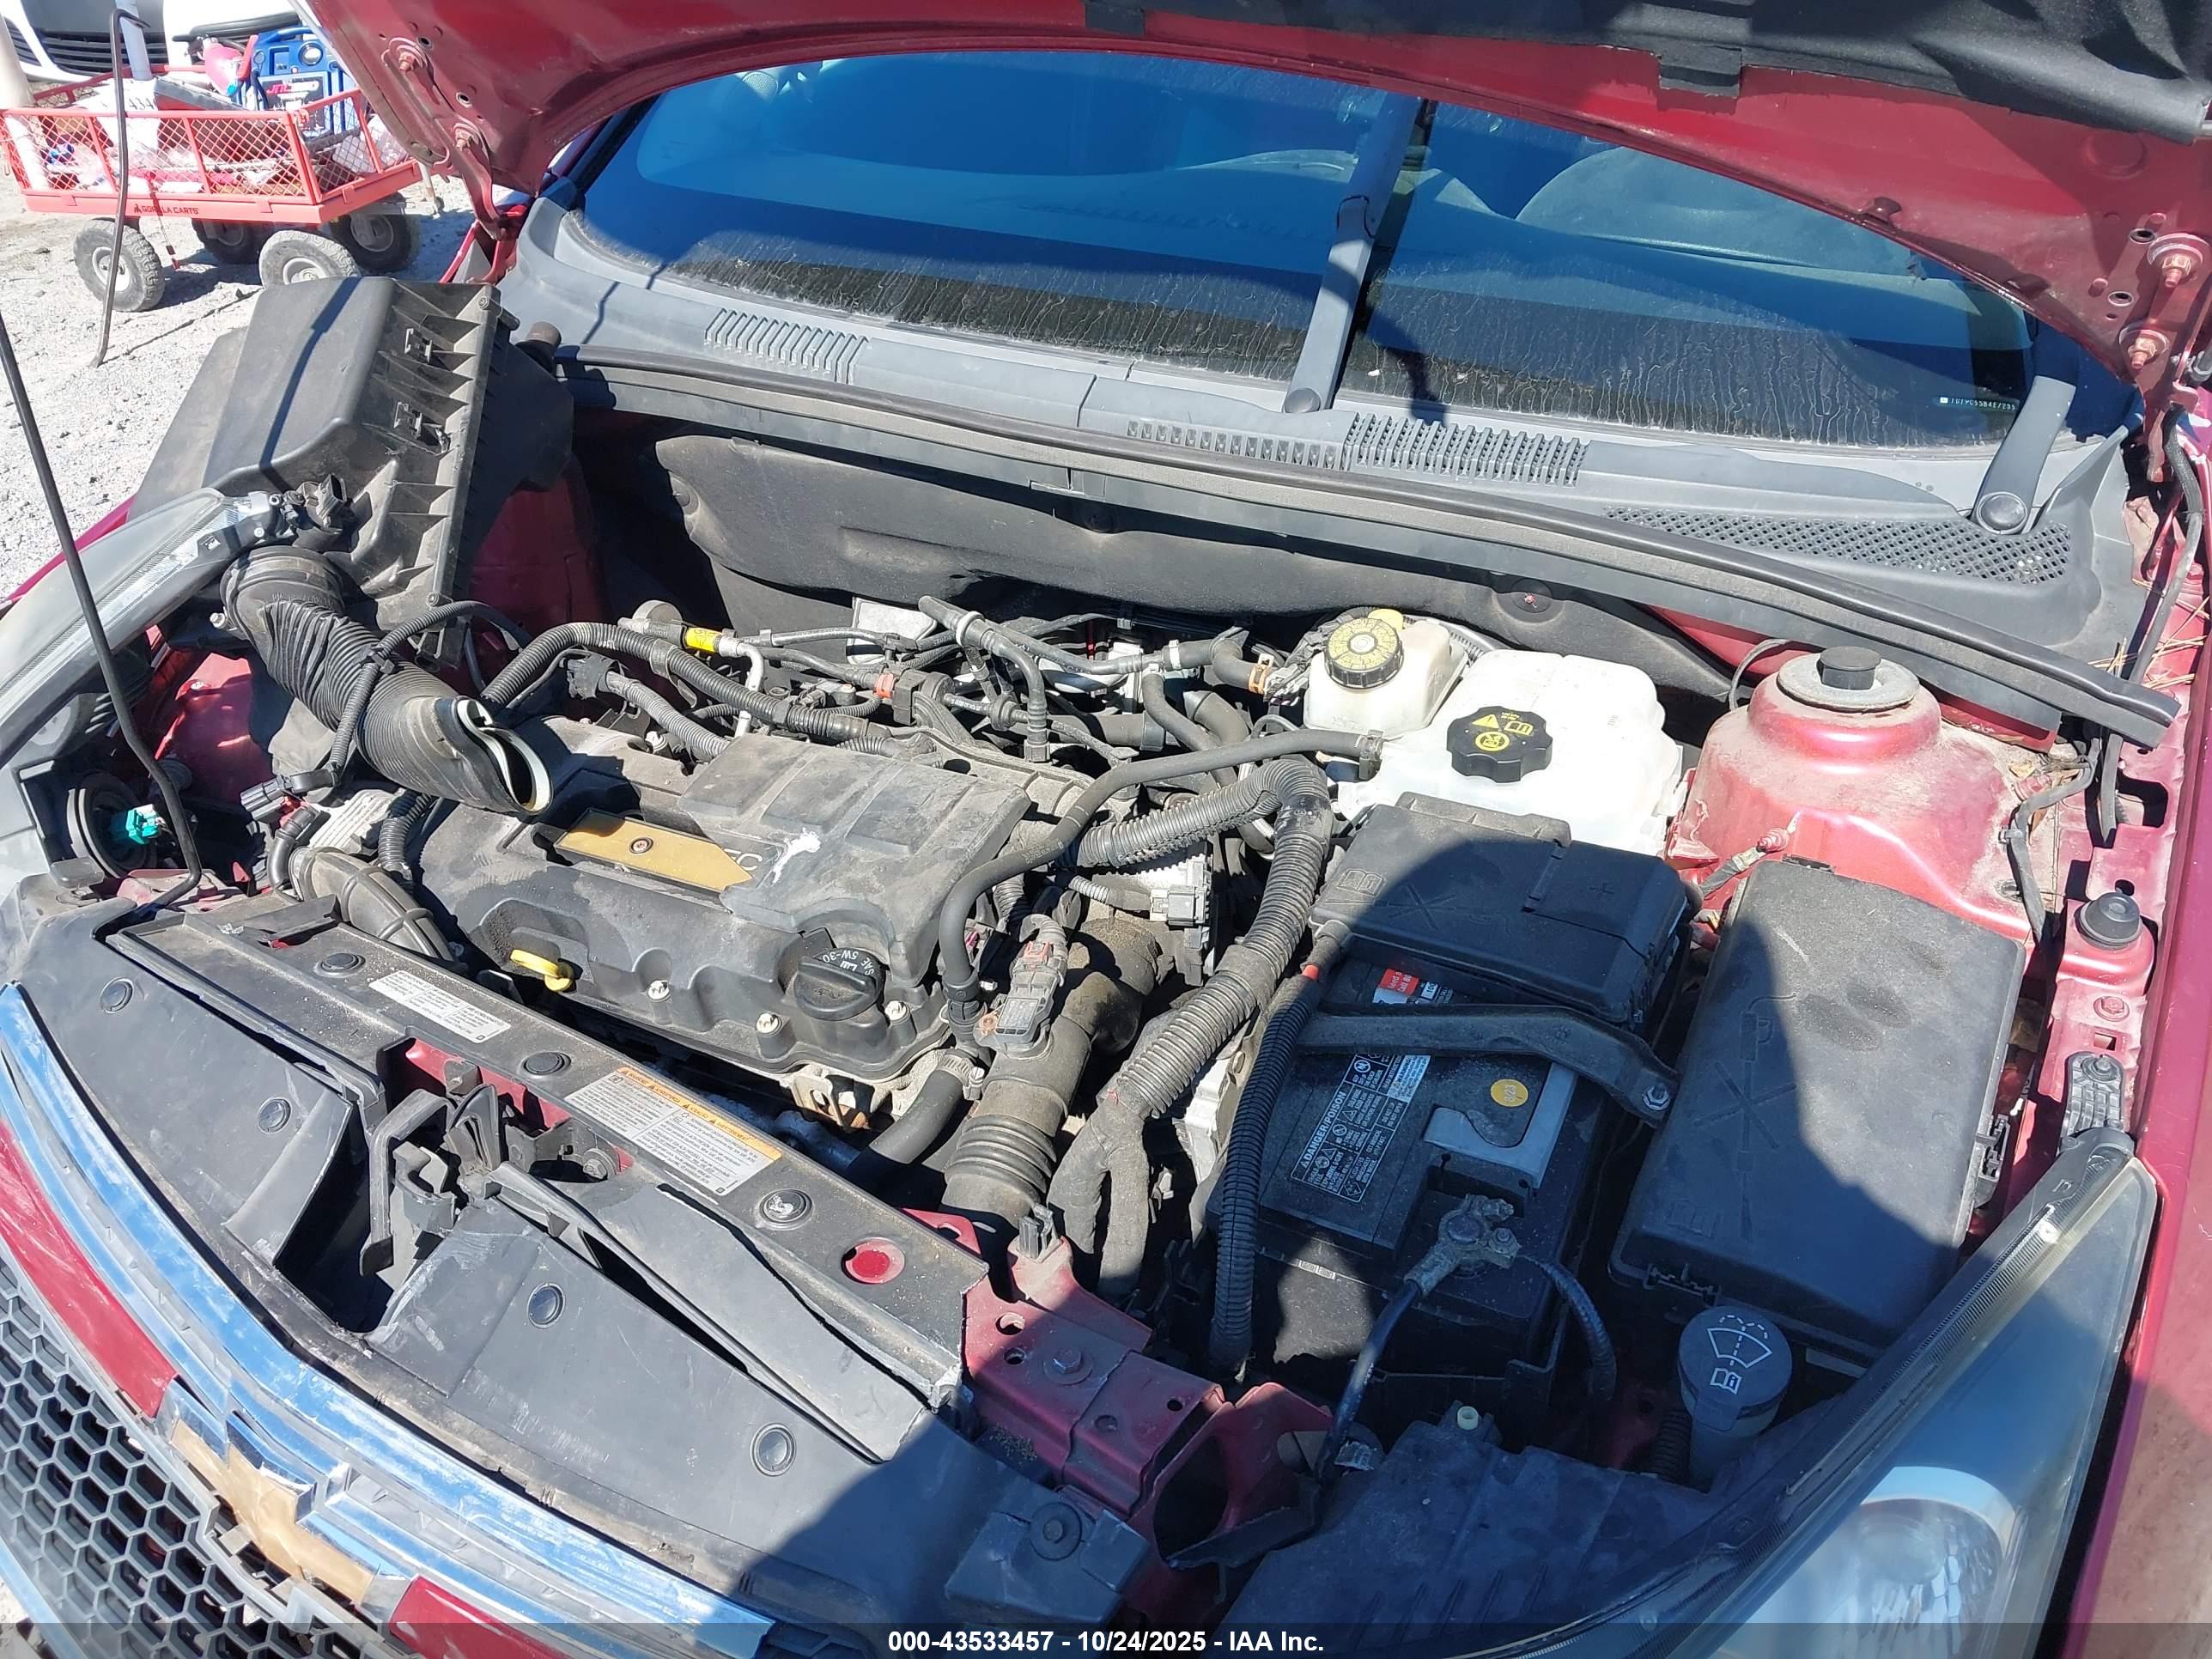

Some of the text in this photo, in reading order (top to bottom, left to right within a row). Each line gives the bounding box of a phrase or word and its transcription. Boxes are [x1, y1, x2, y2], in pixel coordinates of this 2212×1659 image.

[142, 205, 172, 214] GORLA
[823, 950, 874, 975] SAE 5W-30
[1303, 1091, 1346, 1164] DANGER/POISON
